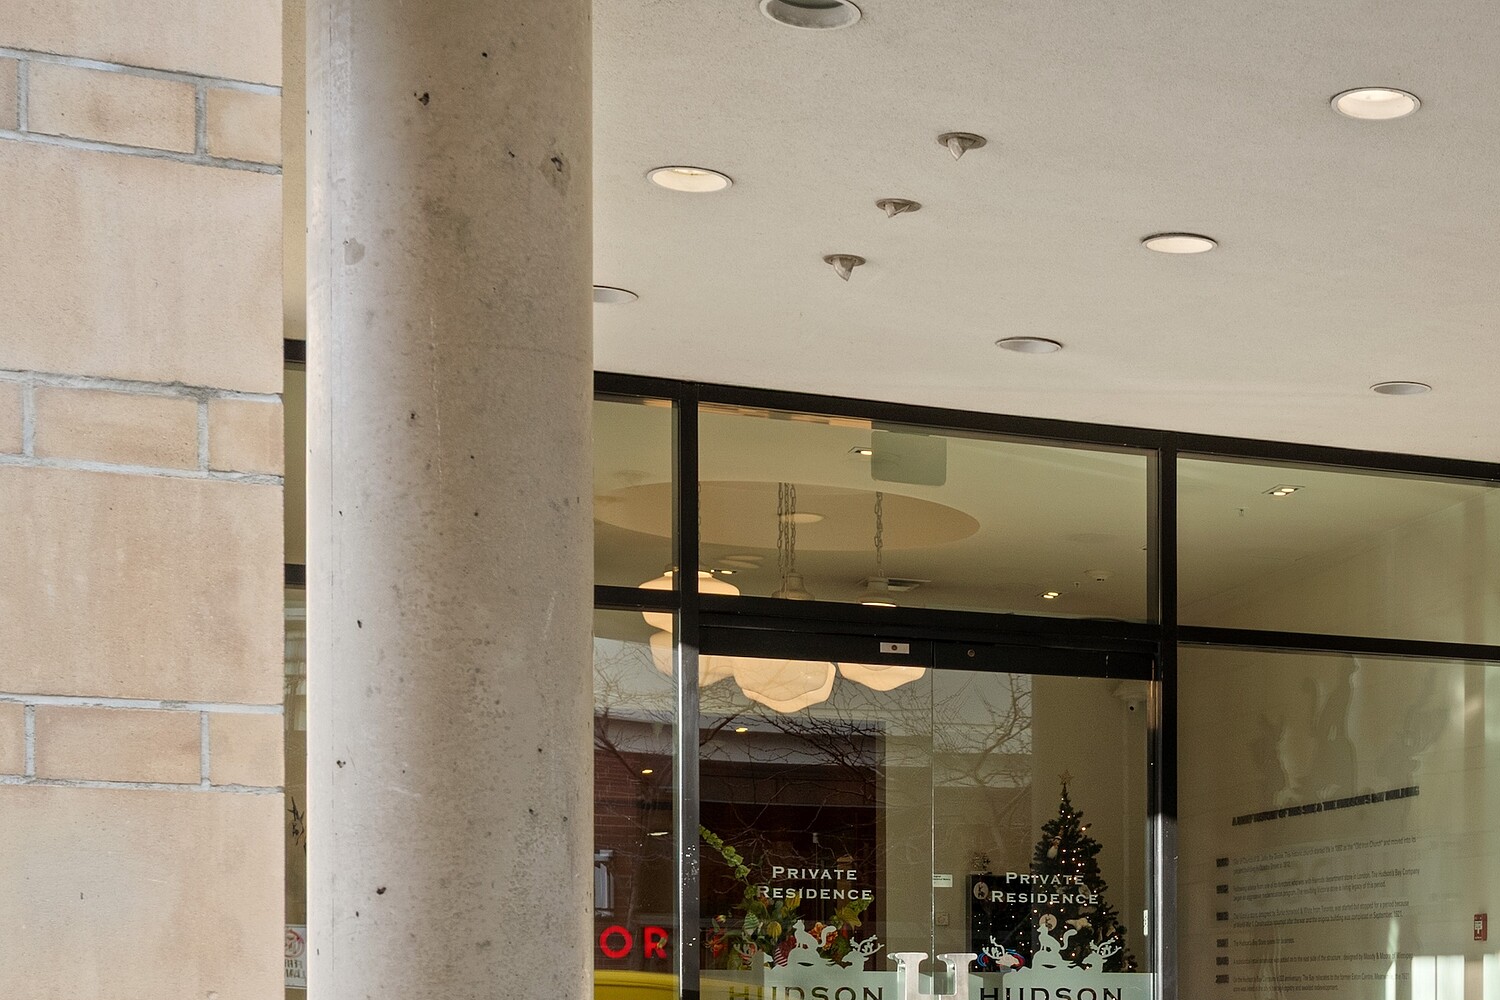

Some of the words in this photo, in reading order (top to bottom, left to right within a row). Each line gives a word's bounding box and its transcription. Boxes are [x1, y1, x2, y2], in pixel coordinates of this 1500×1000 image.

[772, 865, 858, 880] PRIVATE
[757, 885, 872, 901] RESIDENCE
[991, 890, 1099, 904] RESIDENCE
